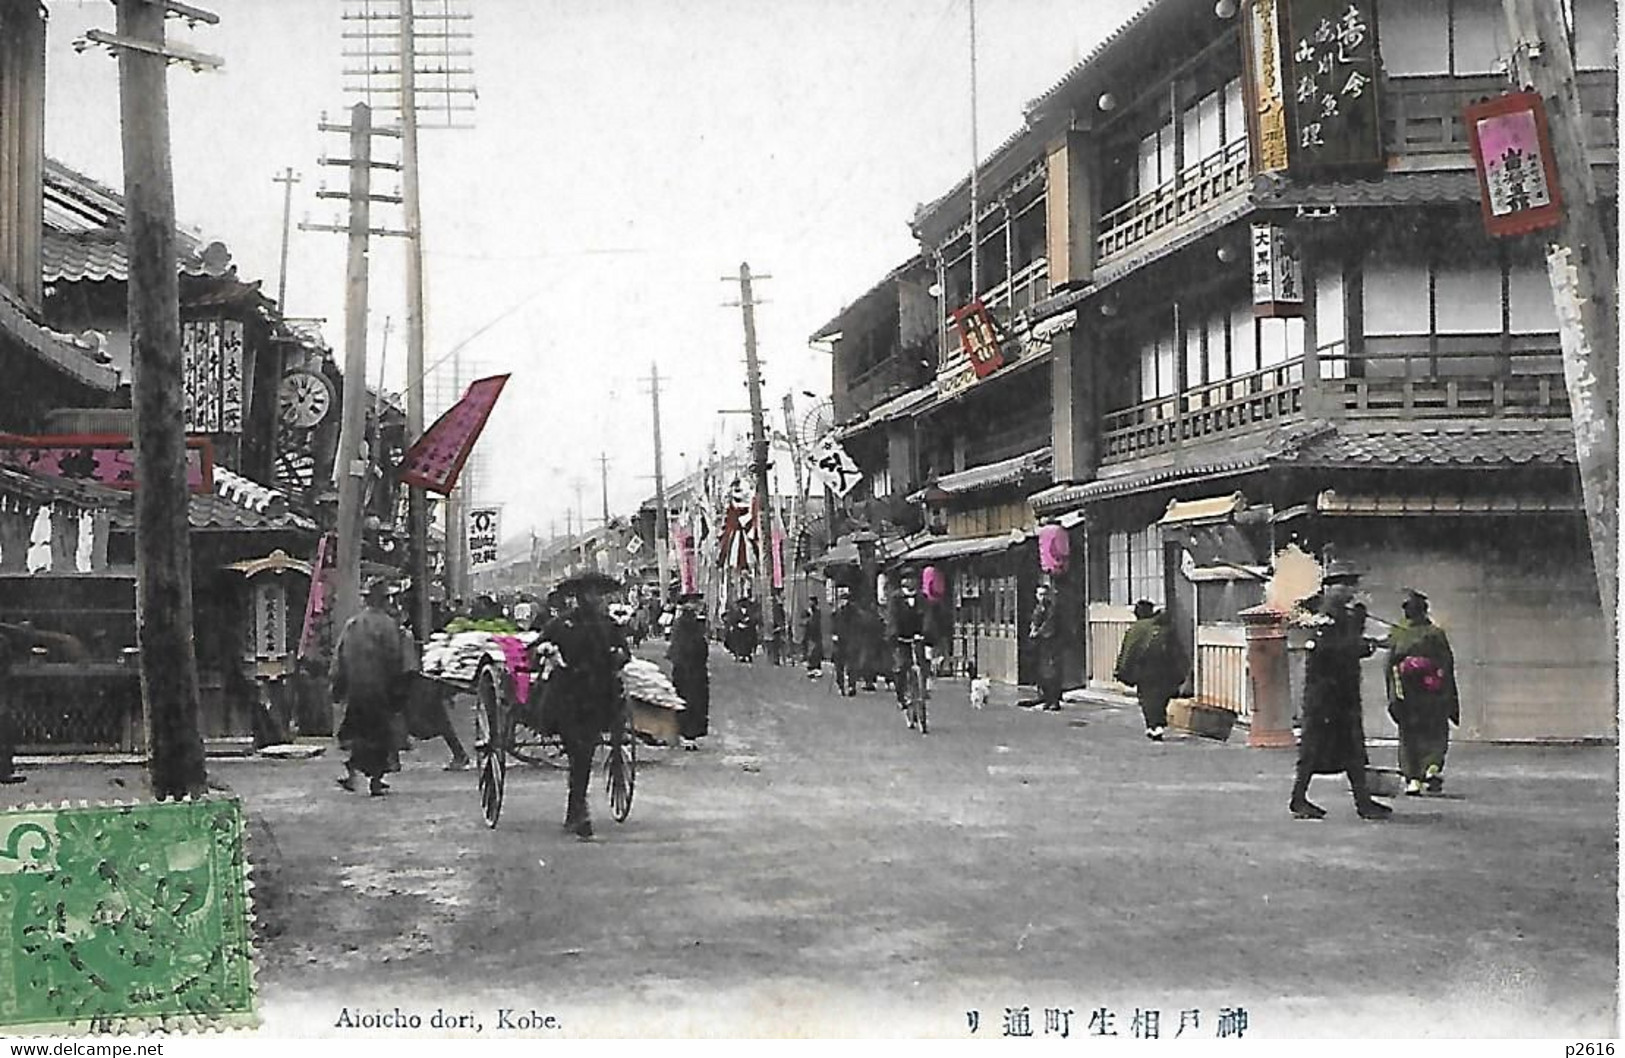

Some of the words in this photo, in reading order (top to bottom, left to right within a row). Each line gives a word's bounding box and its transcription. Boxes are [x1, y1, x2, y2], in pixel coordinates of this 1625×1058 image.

[335, 1007, 422, 1029] Aioicho
[430, 1008, 483, 1033] dori,
[496, 1008, 562, 1030] Kobe.
